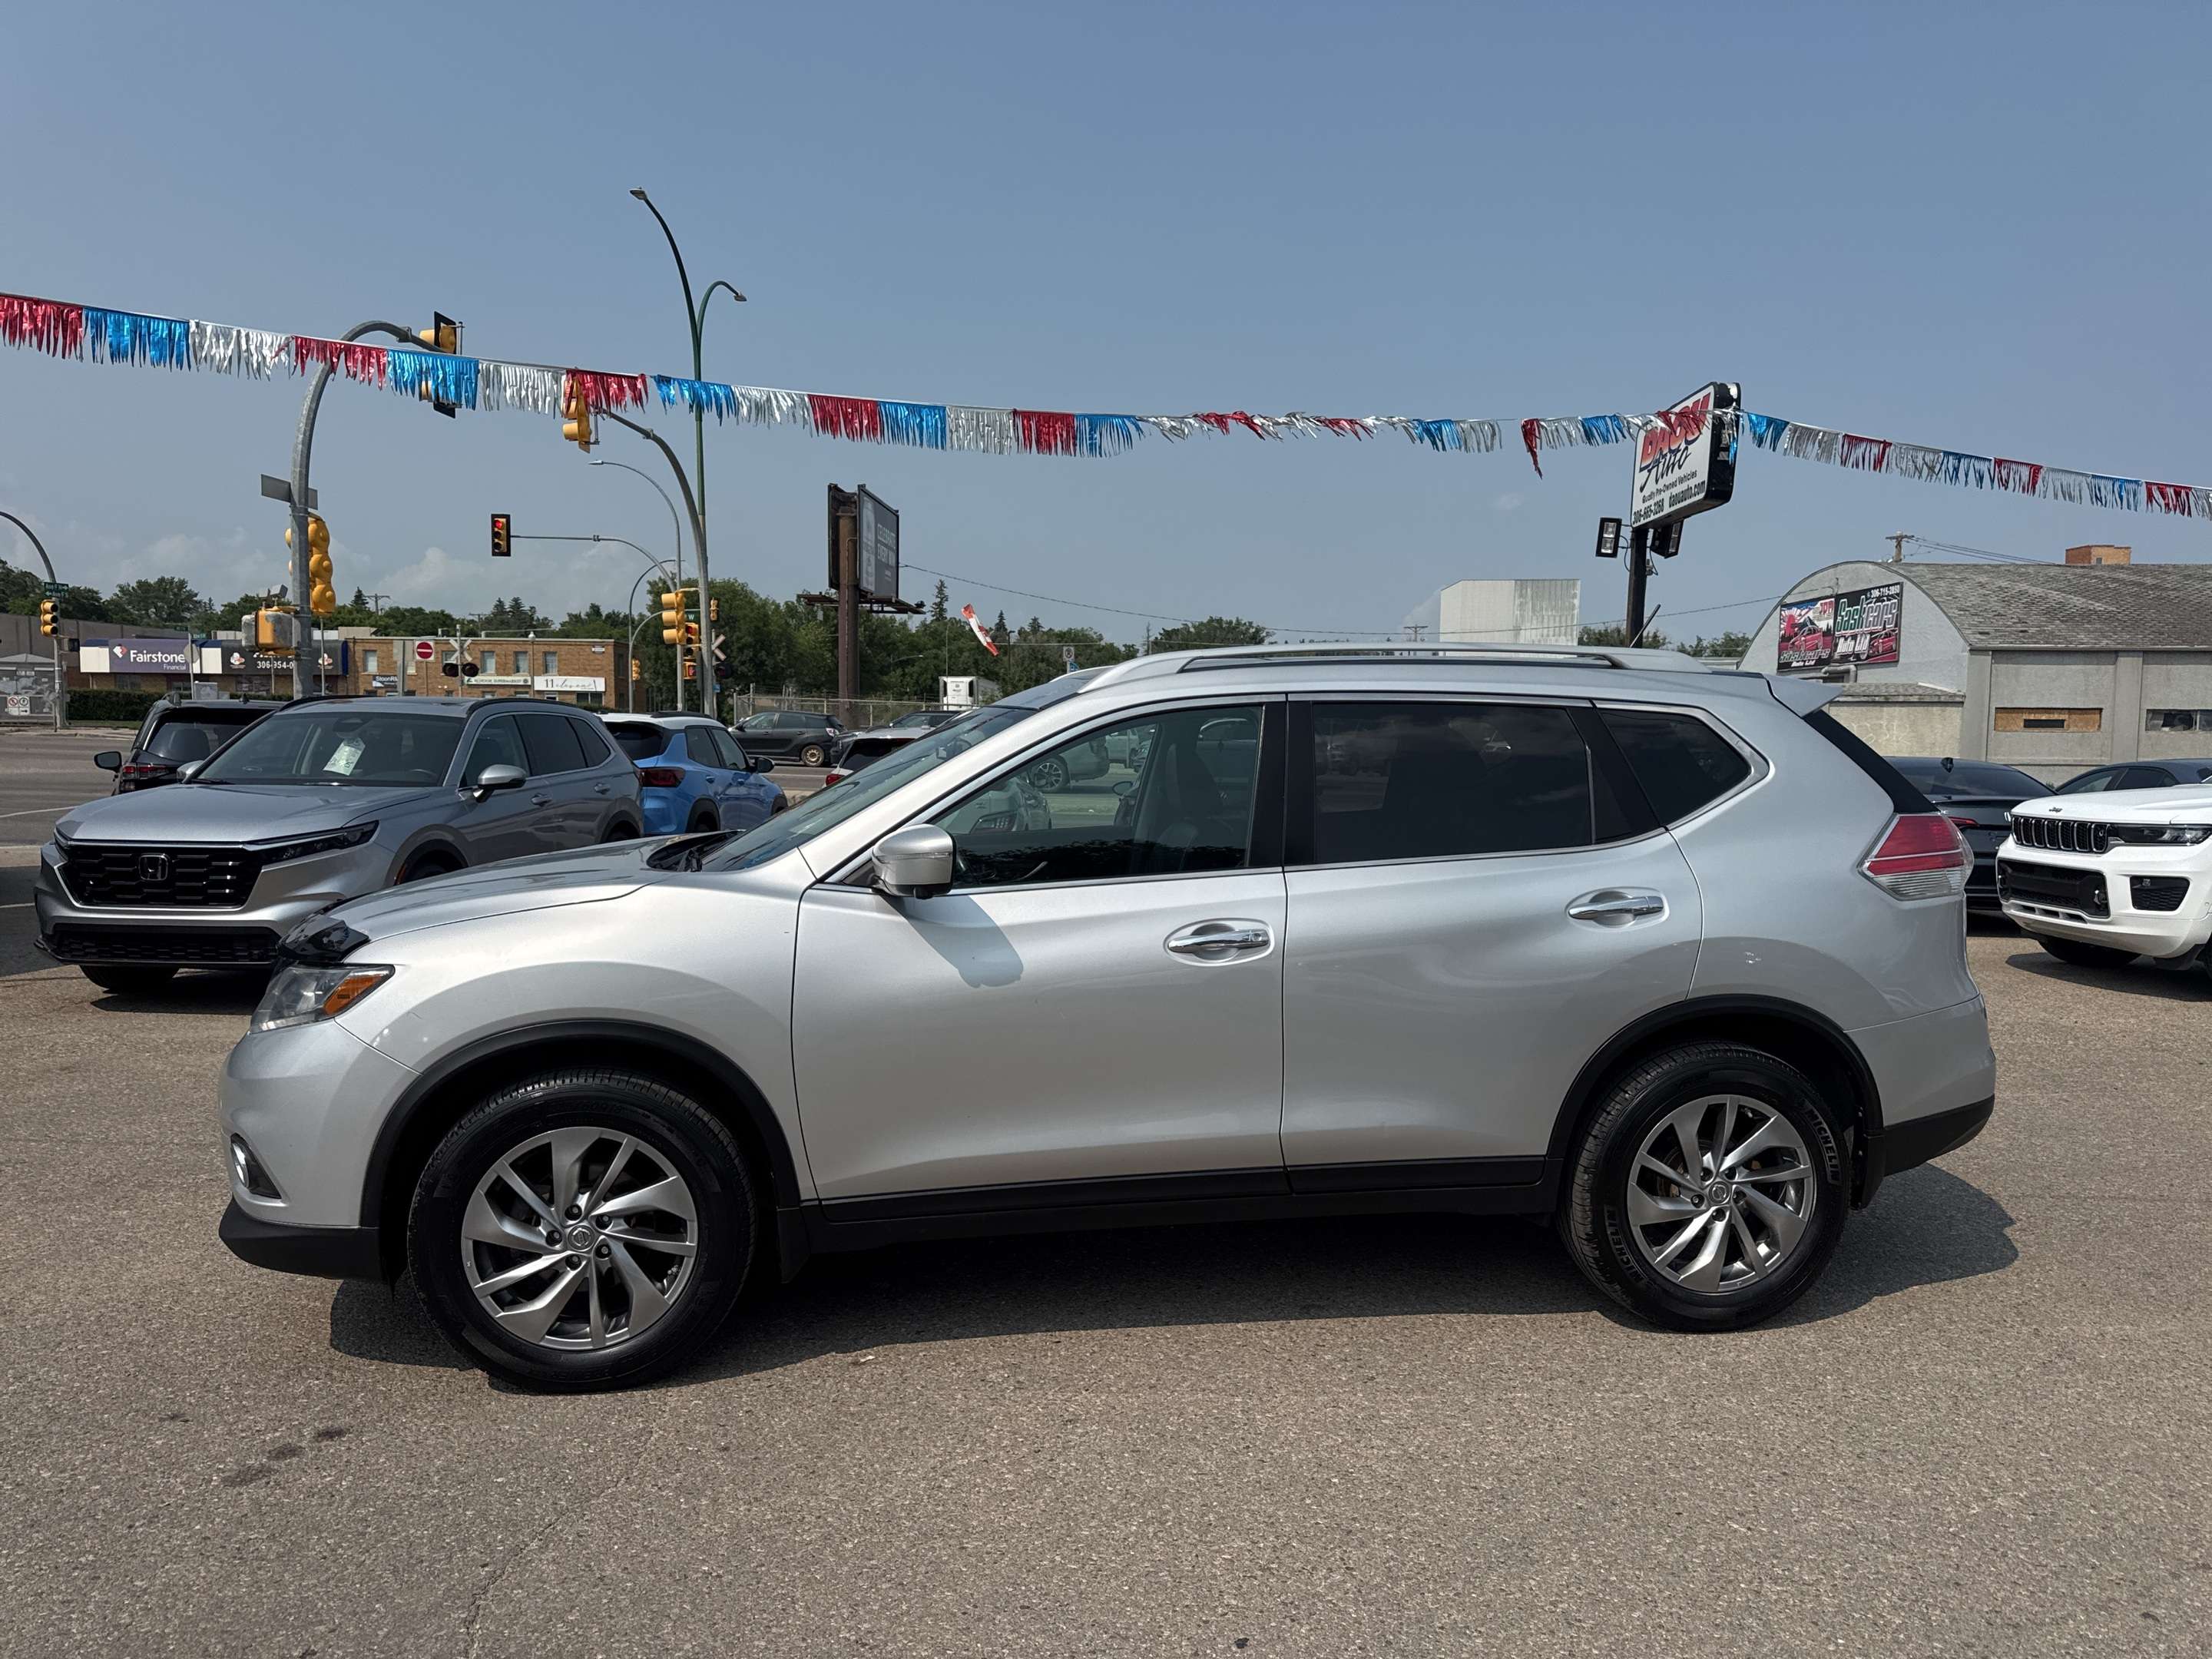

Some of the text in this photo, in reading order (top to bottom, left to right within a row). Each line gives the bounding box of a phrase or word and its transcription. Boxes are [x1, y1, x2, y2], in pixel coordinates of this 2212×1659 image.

[1639, 392, 1711, 472] DAOU
[1640, 445, 1691, 493] Auto
[1678, 470, 1697, 485] Vehicles
[1669, 480, 1706, 508] daouauto.com
[130, 650, 186, 663] Fairstone
[257, 661, 294, 669] 306-954-0
[1805, 1108, 1839, 1181] MICHELIN
[1605, 1205, 1645, 1284] MICHELIN
